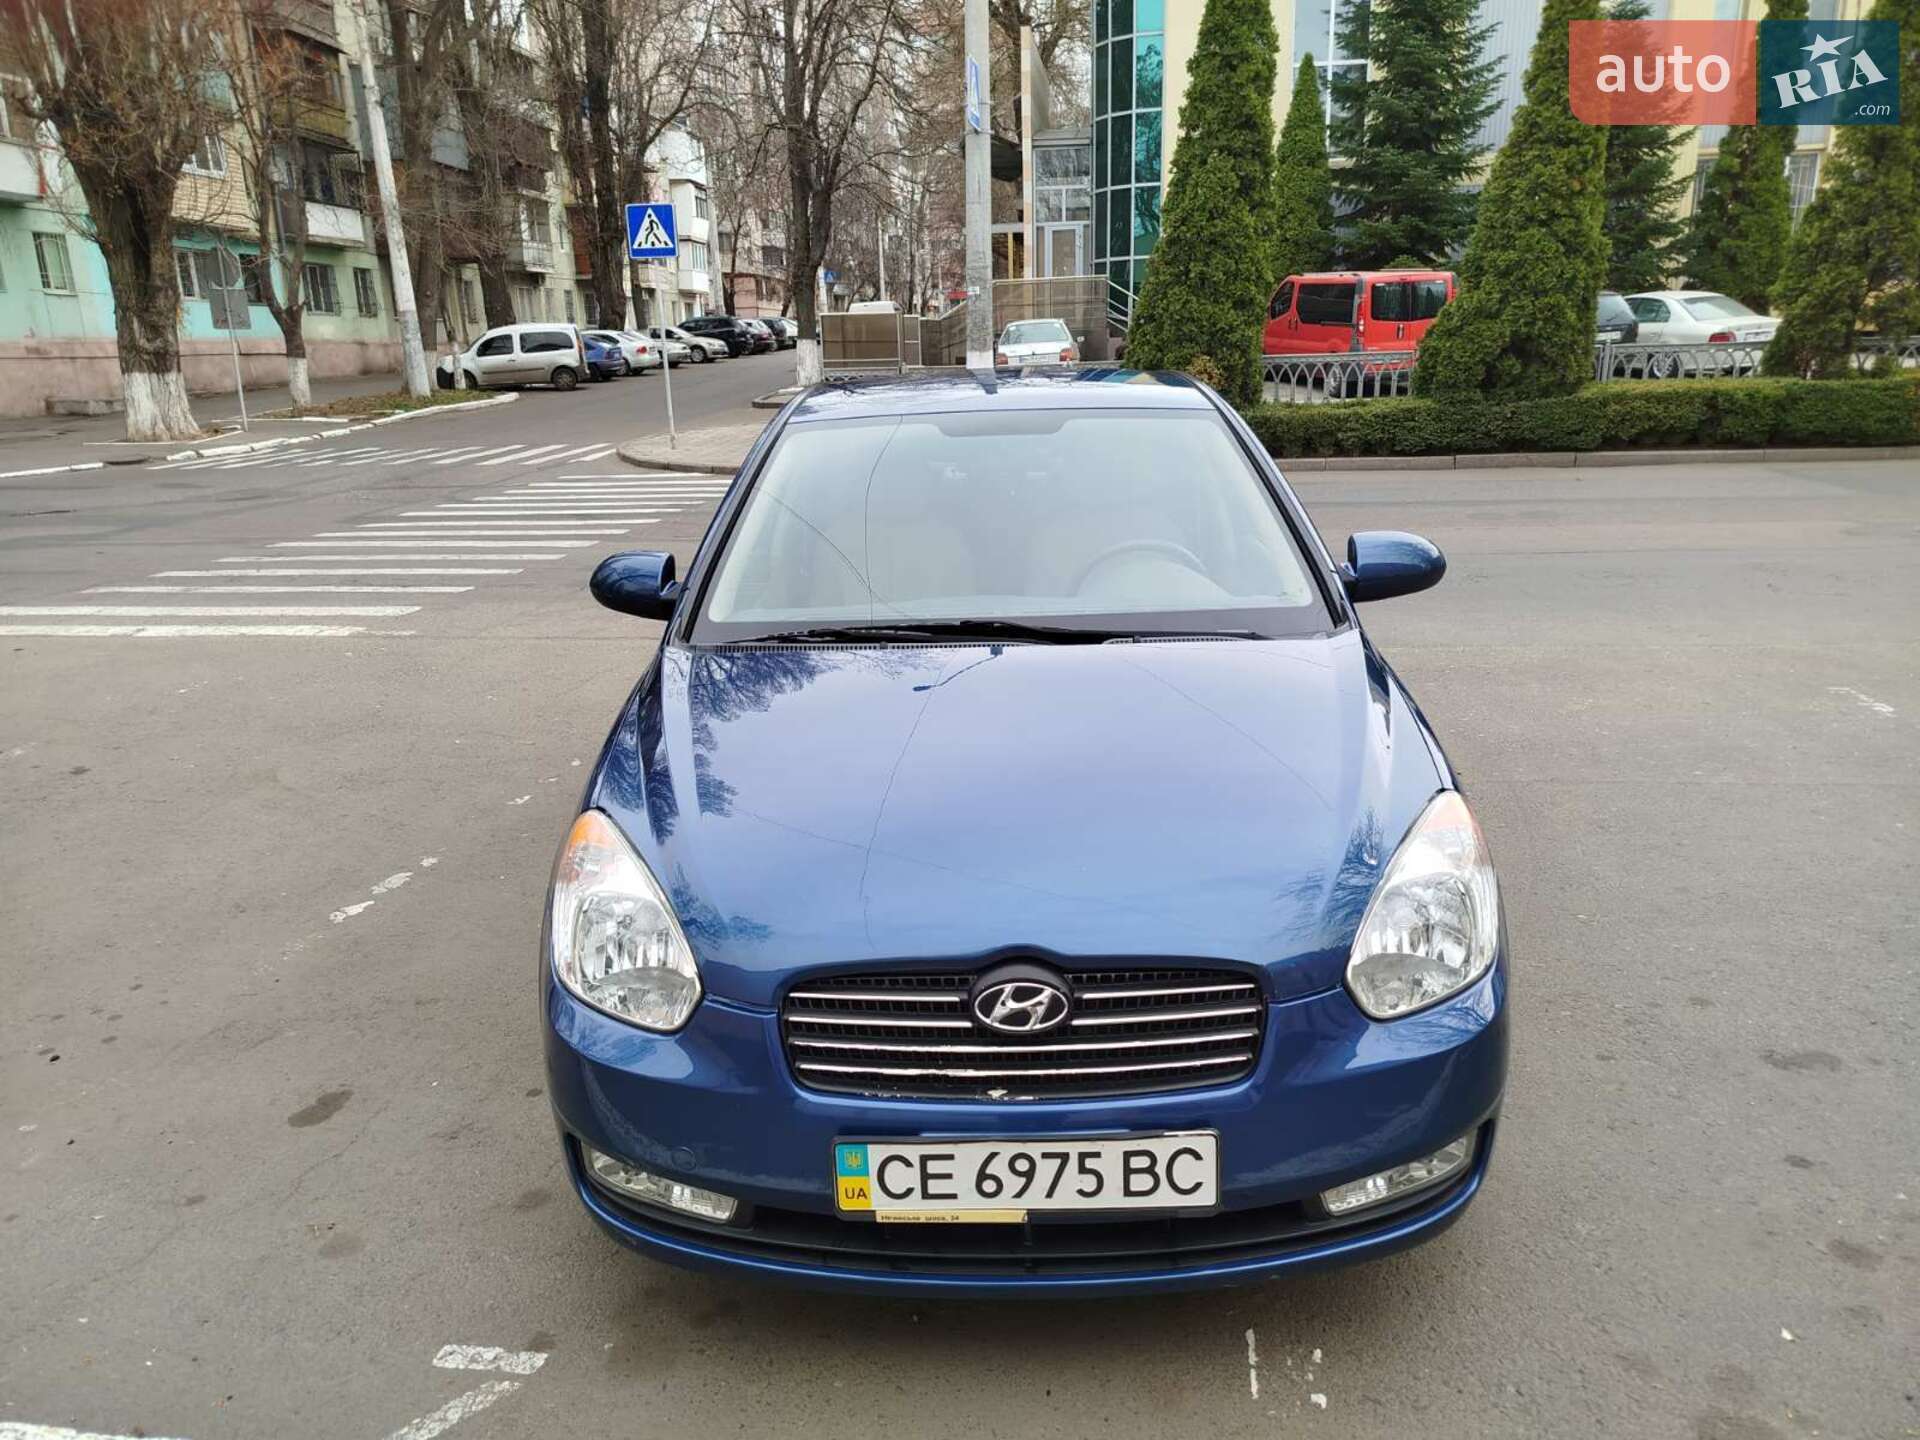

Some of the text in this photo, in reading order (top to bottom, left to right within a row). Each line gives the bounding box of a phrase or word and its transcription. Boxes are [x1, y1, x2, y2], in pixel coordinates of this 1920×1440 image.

[877, 1147, 1204, 1200] CE 6975 BC
[844, 1187, 868, 1200] UA
